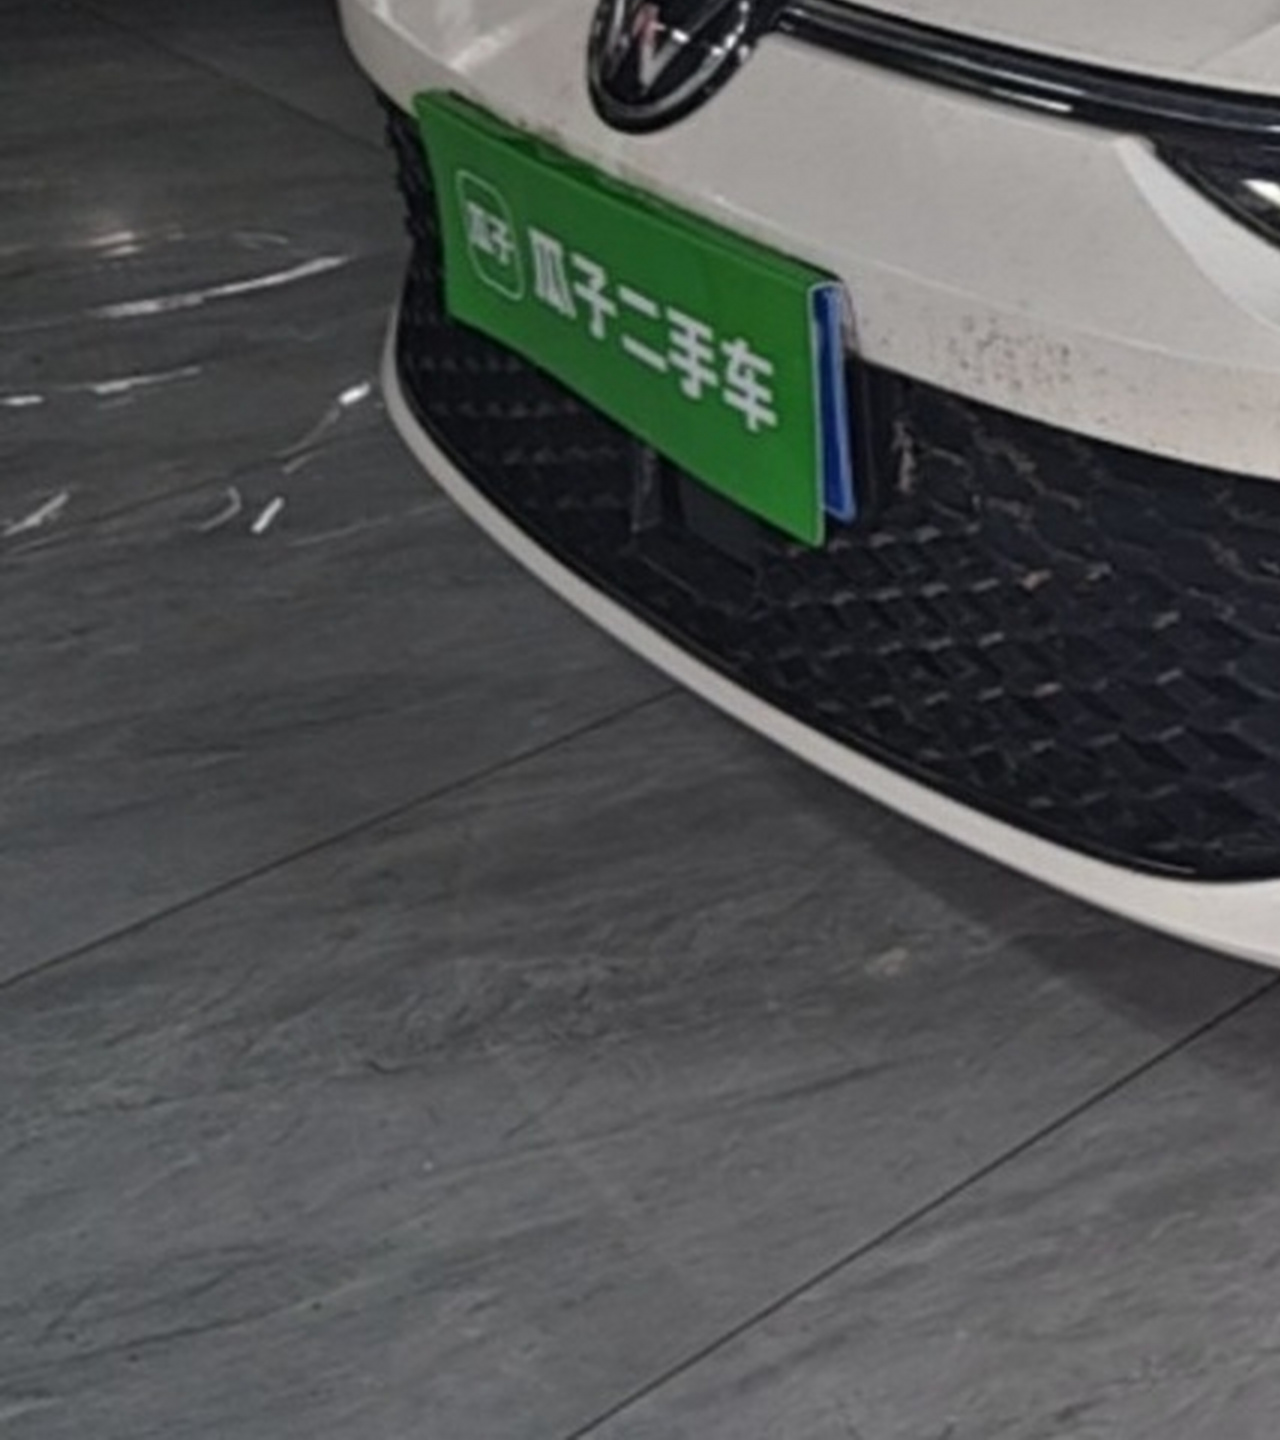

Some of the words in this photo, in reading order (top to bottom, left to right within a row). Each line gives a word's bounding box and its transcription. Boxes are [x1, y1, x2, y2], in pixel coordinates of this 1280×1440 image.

[528, 226, 778, 433] 瓜子二手车
